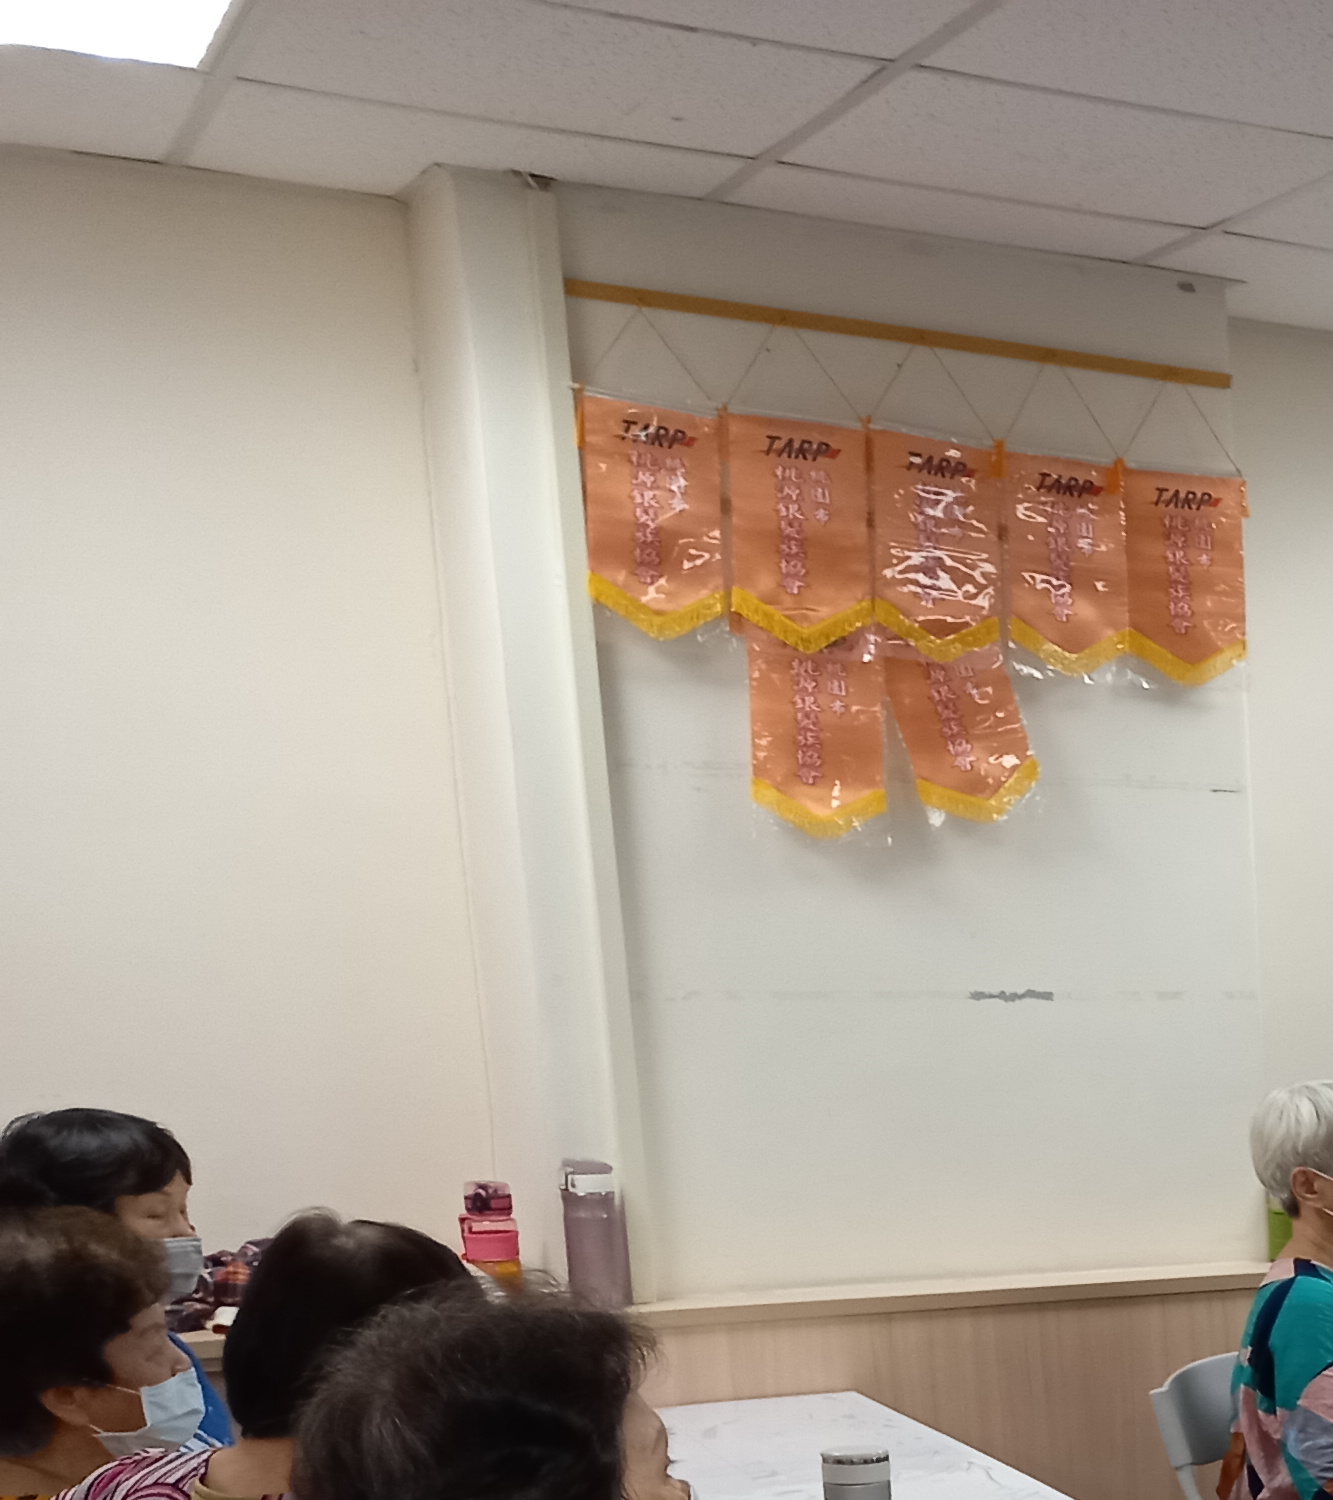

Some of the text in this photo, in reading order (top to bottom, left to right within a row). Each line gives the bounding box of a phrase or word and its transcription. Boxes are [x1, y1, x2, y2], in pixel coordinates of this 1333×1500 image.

[765, 434, 831, 462] TARP
[1036, 471, 1095, 499] TARP
[1153, 486, 1213, 512] TARP
